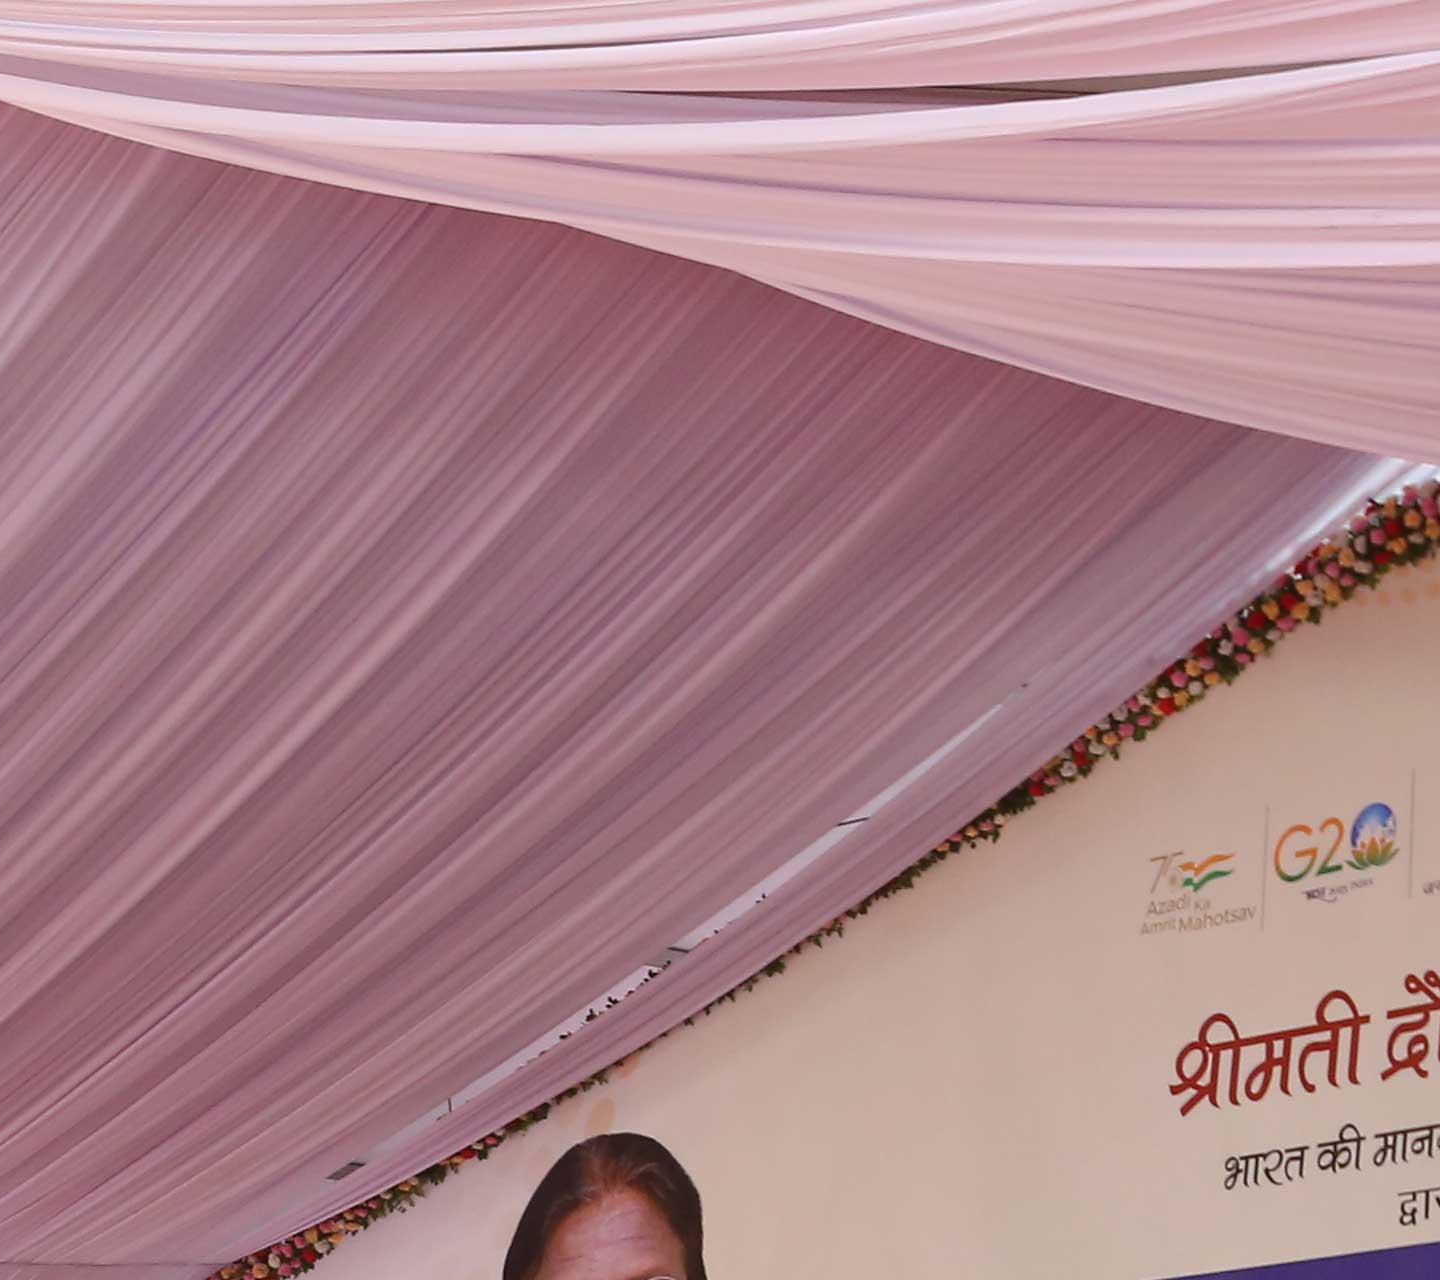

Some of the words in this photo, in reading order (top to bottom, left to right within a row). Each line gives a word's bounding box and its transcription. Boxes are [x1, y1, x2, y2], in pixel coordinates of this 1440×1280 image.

[1178, 904, 1258, 933] Mahotsav
[1169, 990, 1371, 1117] श्रीमती
[1222, 1144, 1306, 1191] भारत
[1317, 1123, 1364, 1173] की
